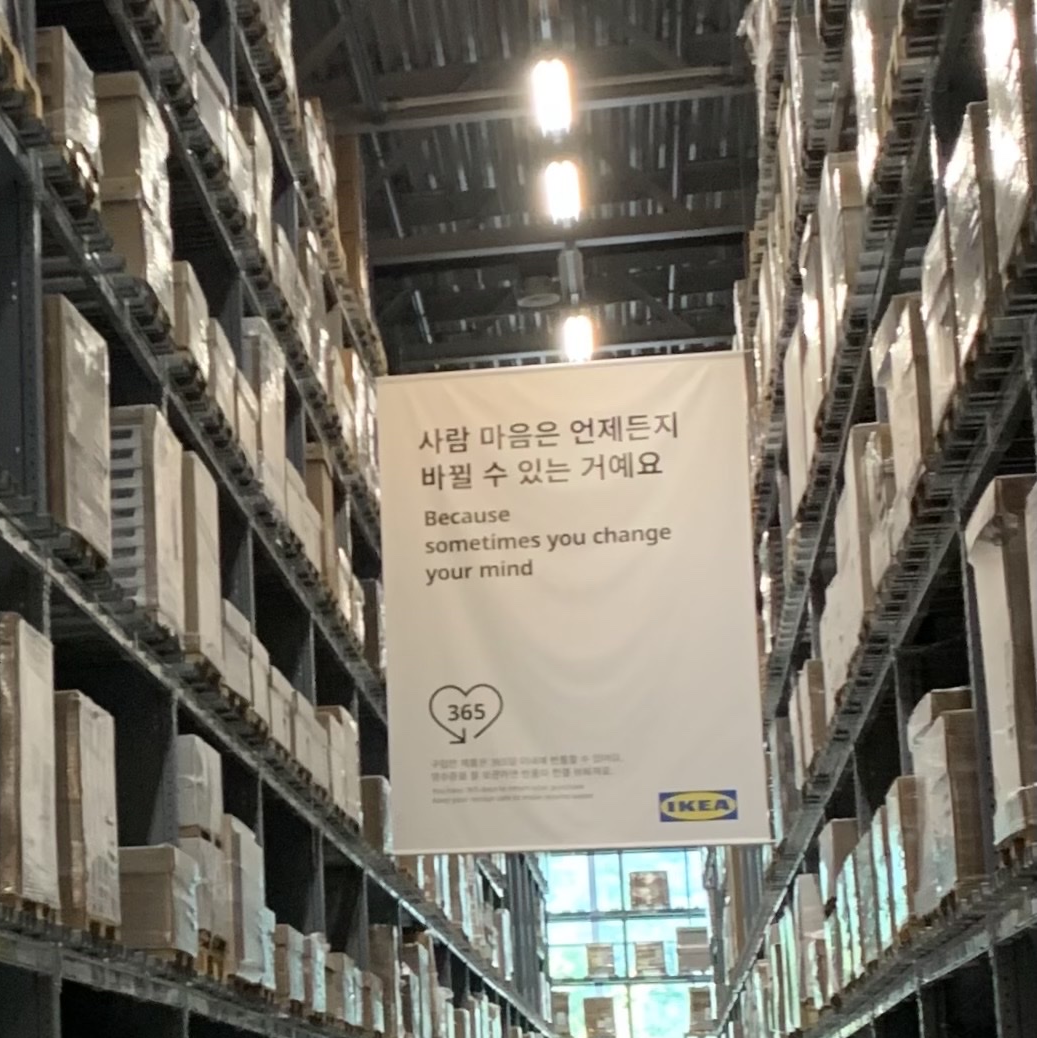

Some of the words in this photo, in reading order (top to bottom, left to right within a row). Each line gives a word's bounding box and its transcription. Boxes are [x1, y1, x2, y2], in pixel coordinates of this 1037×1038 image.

[419, 426, 470, 454] 사람
[480, 420, 560, 450] 마음은
[570, 411, 679, 445] 언제든지
[421, 462, 472, 491] 바뀔
[482, 462, 509, 488] 수
[518, 457, 571, 485] 있는
[581, 451, 663, 481] 거예요
[424, 508, 511, 527] Because
[425, 532, 541, 554] sometimes
[546, 531, 586, 552] you
[592, 525, 672, 546] change
[425, 565, 474, 586] your
[479, 559, 534, 579] mind
[447, 703, 486, 721] 365
[667, 799, 730, 813] IKEA
